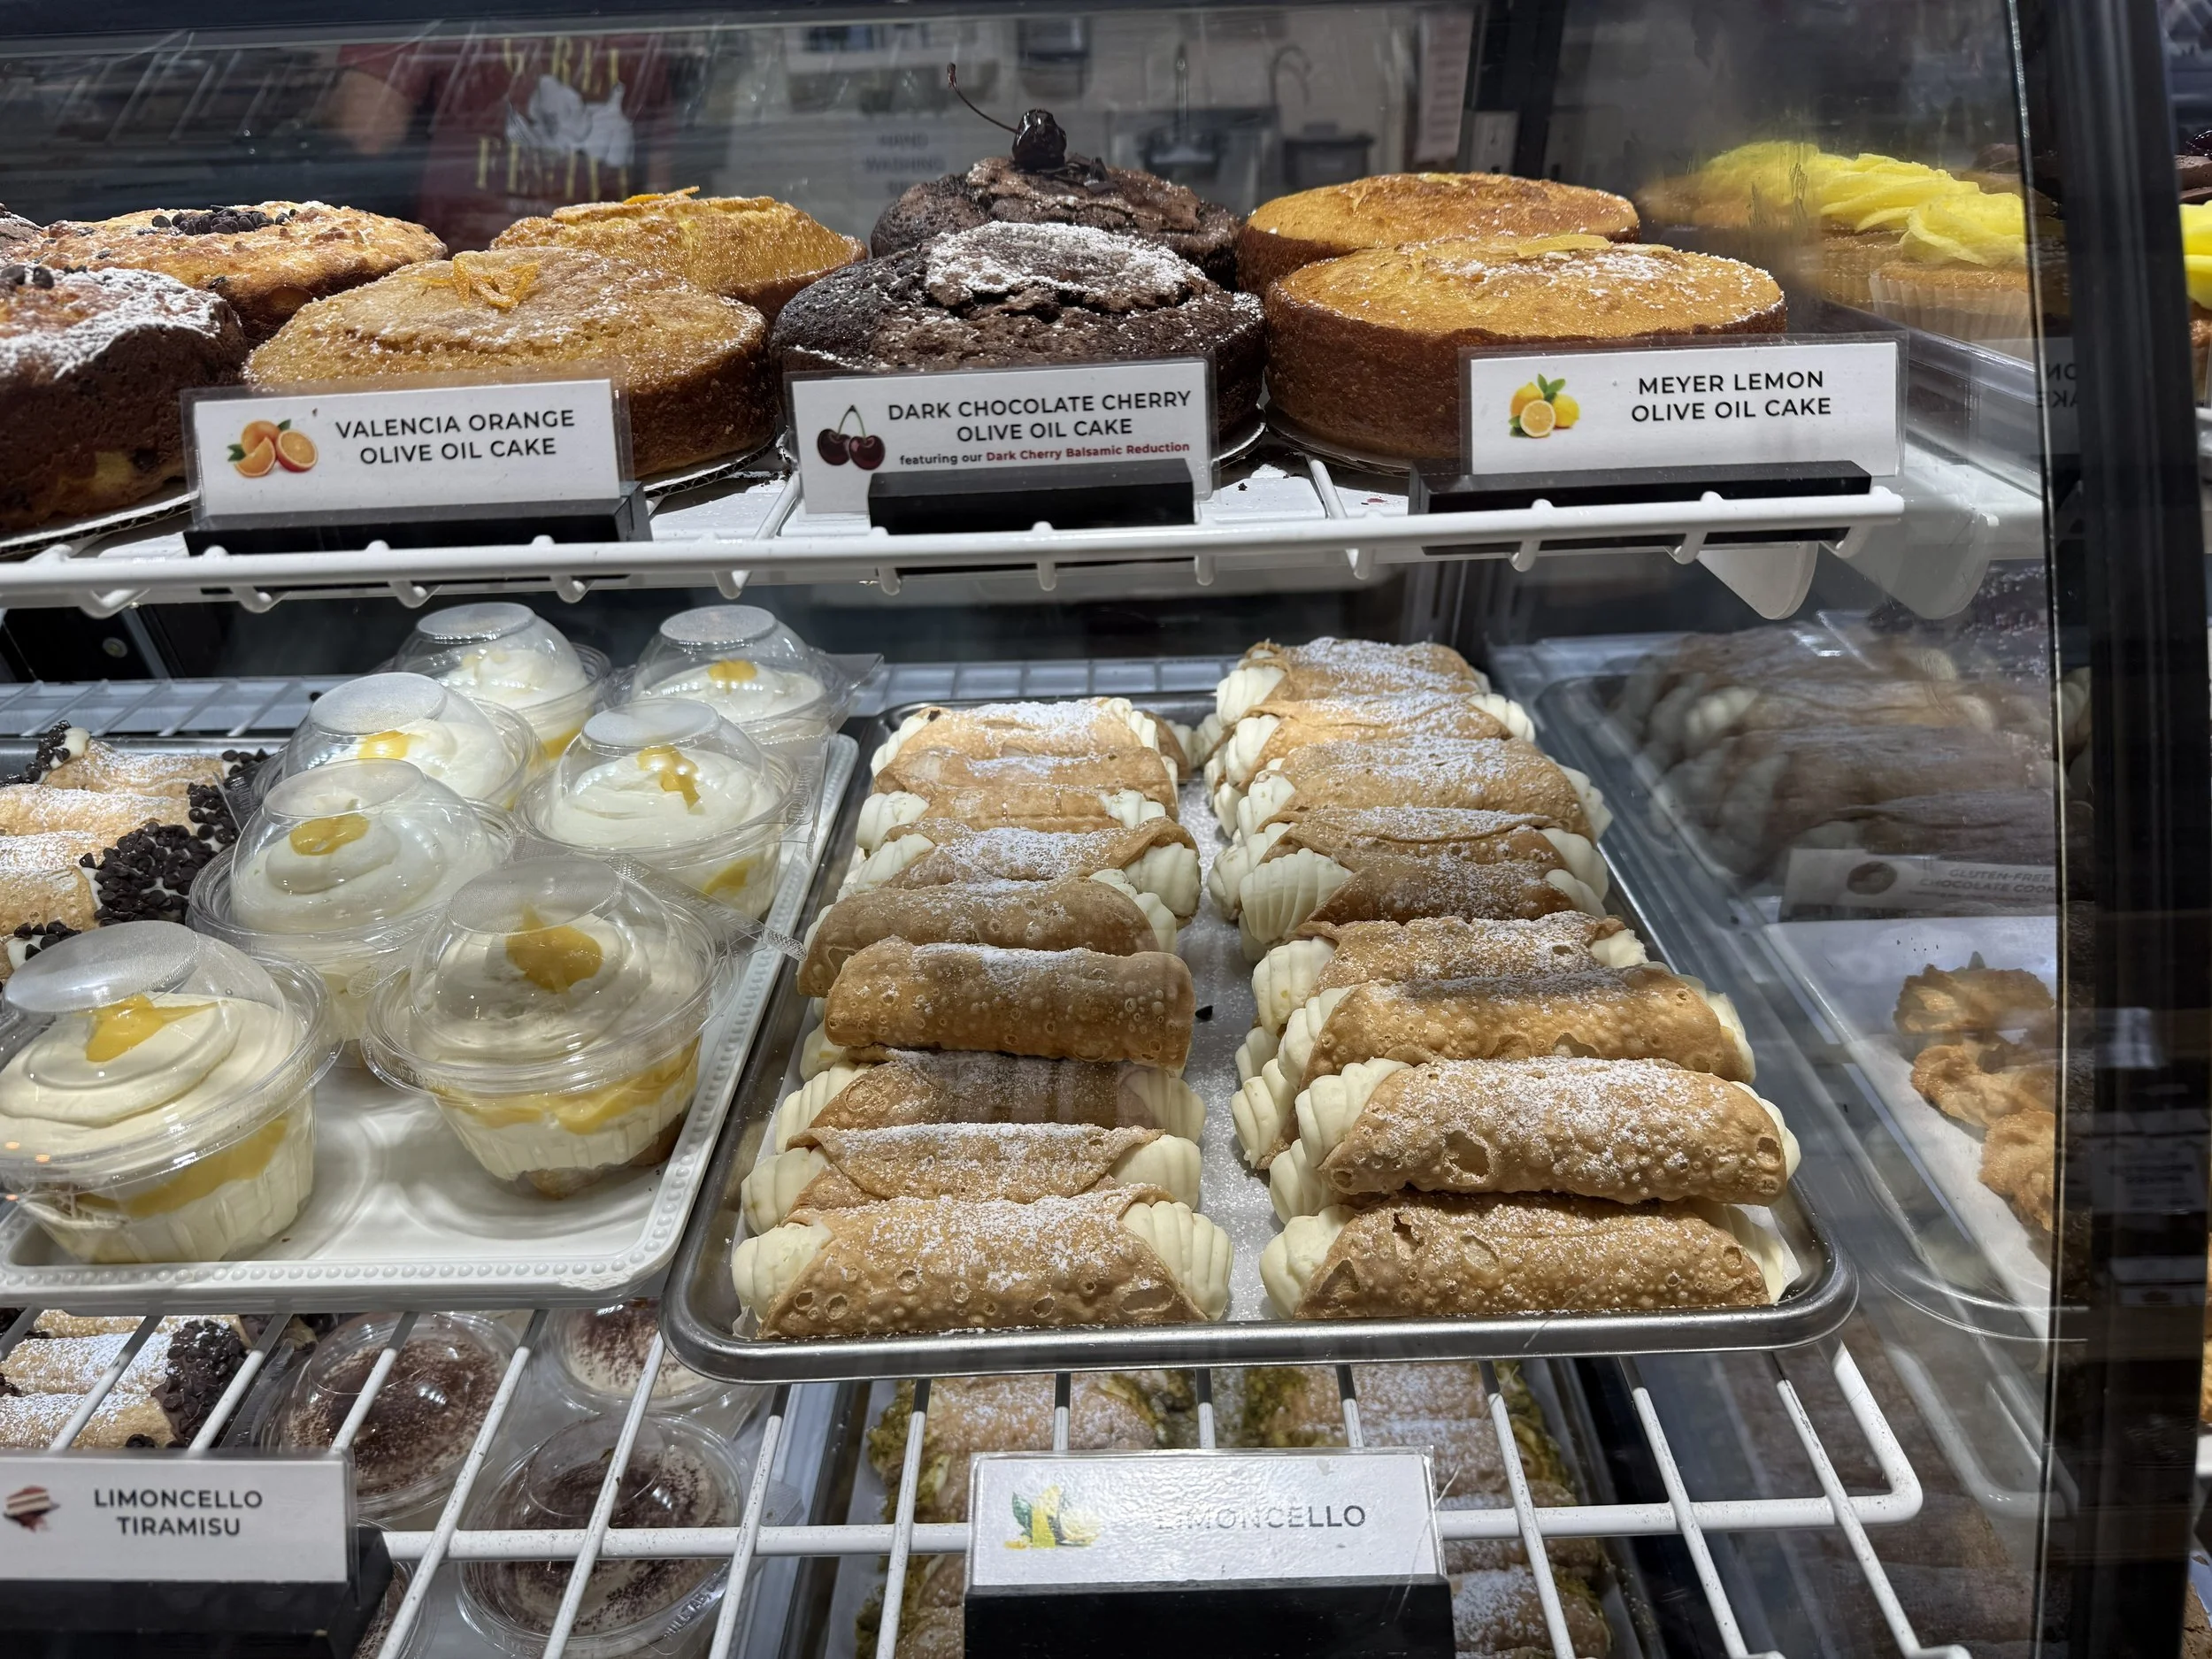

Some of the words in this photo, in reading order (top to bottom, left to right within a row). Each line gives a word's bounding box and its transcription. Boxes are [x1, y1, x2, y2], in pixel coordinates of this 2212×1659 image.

[1638, 374, 1724, 395] MEYER
[1734, 371, 1824, 391] LEMON
[887, 402, 951, 420] DARK
[957, 396, 1094, 418] CHOCOLATE
[1102, 390, 1191, 411] CHERRY
[1631, 403, 1706, 422] OLIVE
[1715, 401, 1756, 419] OIL
[1764, 397, 1832, 417] CAKE
[335, 415, 461, 439] VALENCIA
[468, 410, 575, 432] ORANGE
[956, 424, 1023, 442] OLIVE
[1029, 421, 1067, 439] OIL
[1073, 418, 1133, 436] CAKE
[359, 444, 434, 465] OLIVE
[441, 442, 483, 460] OIL
[489, 437, 557, 458] CAKE
[899, 452, 958, 466] featuring
[962, 452, 982, 463] our
[987, 449, 1017, 462] Dark
[1019, 449, 1063, 462] Cherry
[1065, 445, 1122, 458] Balsamic
[1125, 442, 1190, 456] Reduction
[1919, 878, 2008, 893] CHOCOLATE
[1948, 868, 2052, 883] GLUTEN-FREE
[94, 1488, 263, 1509] LIMONCELLO
[116, 1516, 242, 1536] TIRAMISU
[1156, 1504, 1366, 1530] LMONCELLO
